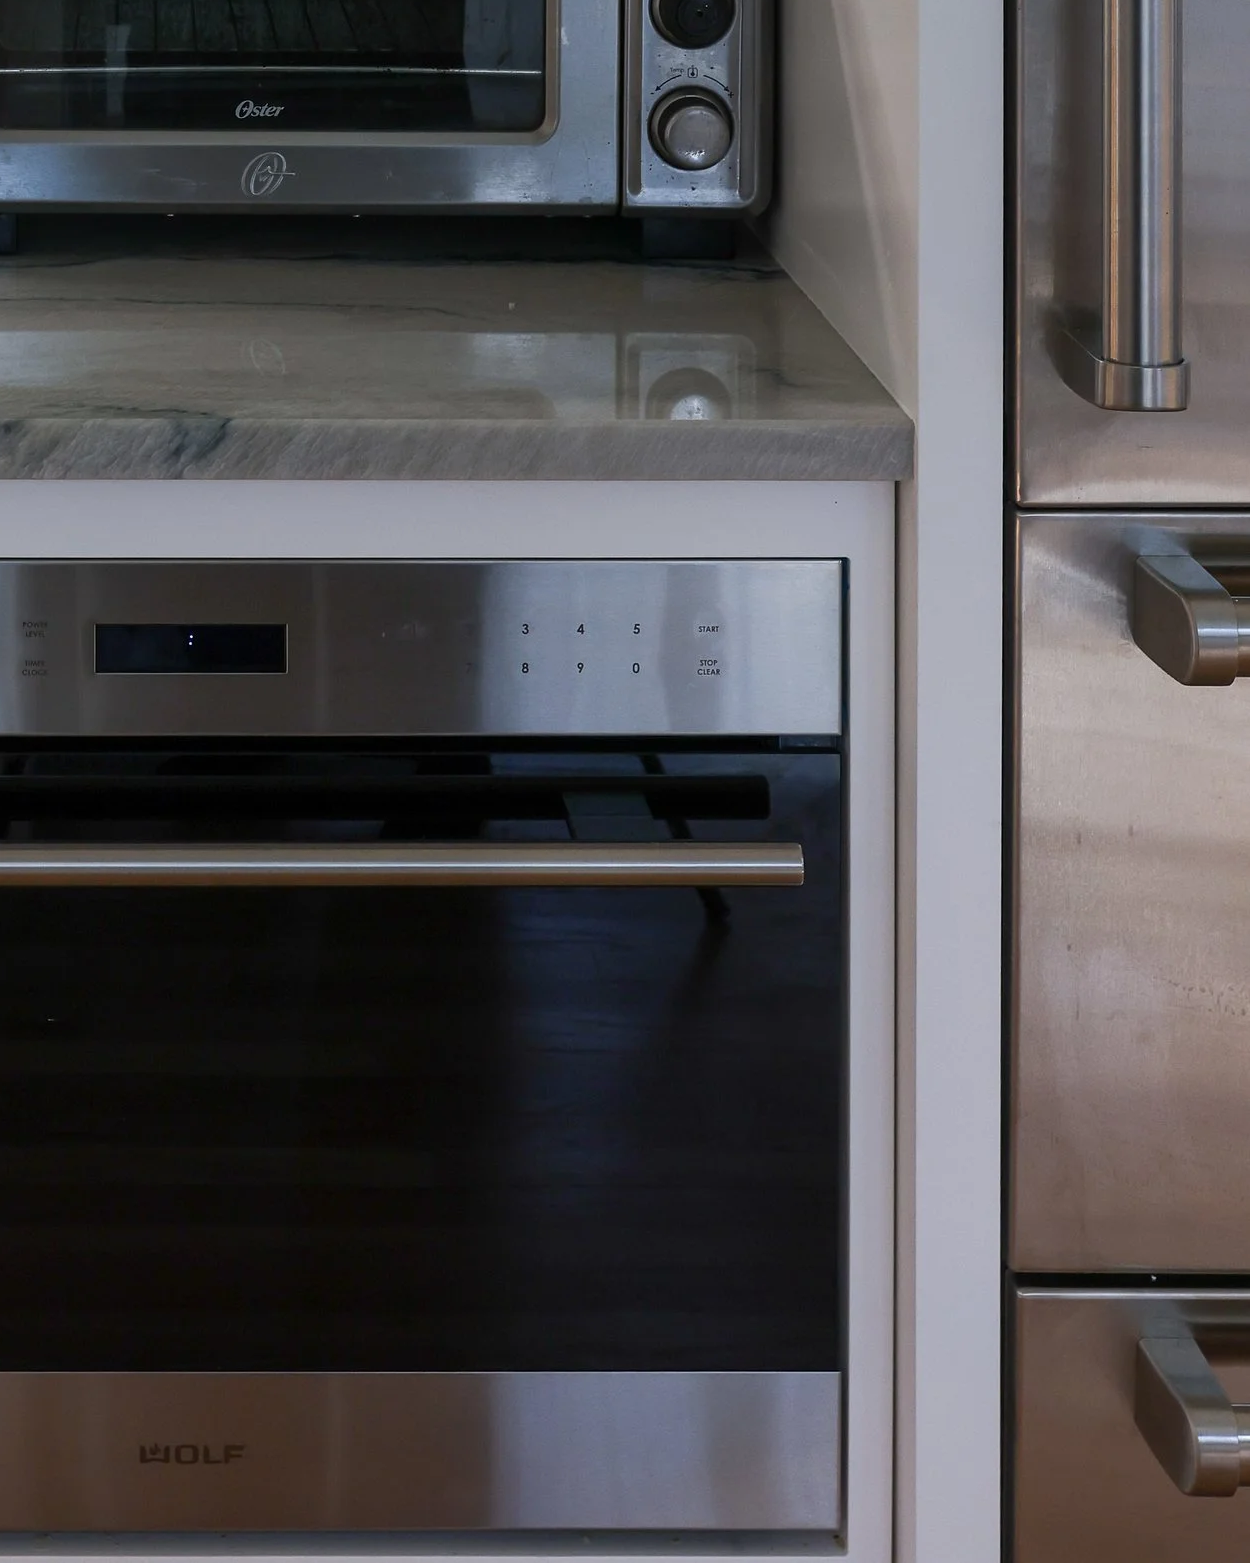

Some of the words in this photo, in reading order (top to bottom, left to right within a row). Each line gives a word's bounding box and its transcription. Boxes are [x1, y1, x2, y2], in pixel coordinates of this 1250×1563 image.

[235, 100, 284, 119] Oster
[522, 623, 529, 635] 3
[576, 624, 584, 634] 4
[633, 624, 640, 634] 5
[521, 662, 529, 673] 8
[577, 662, 584, 673] 9
[697, 668, 721, 676] CLEAR
[140, 1443, 245, 1464] WOLF
